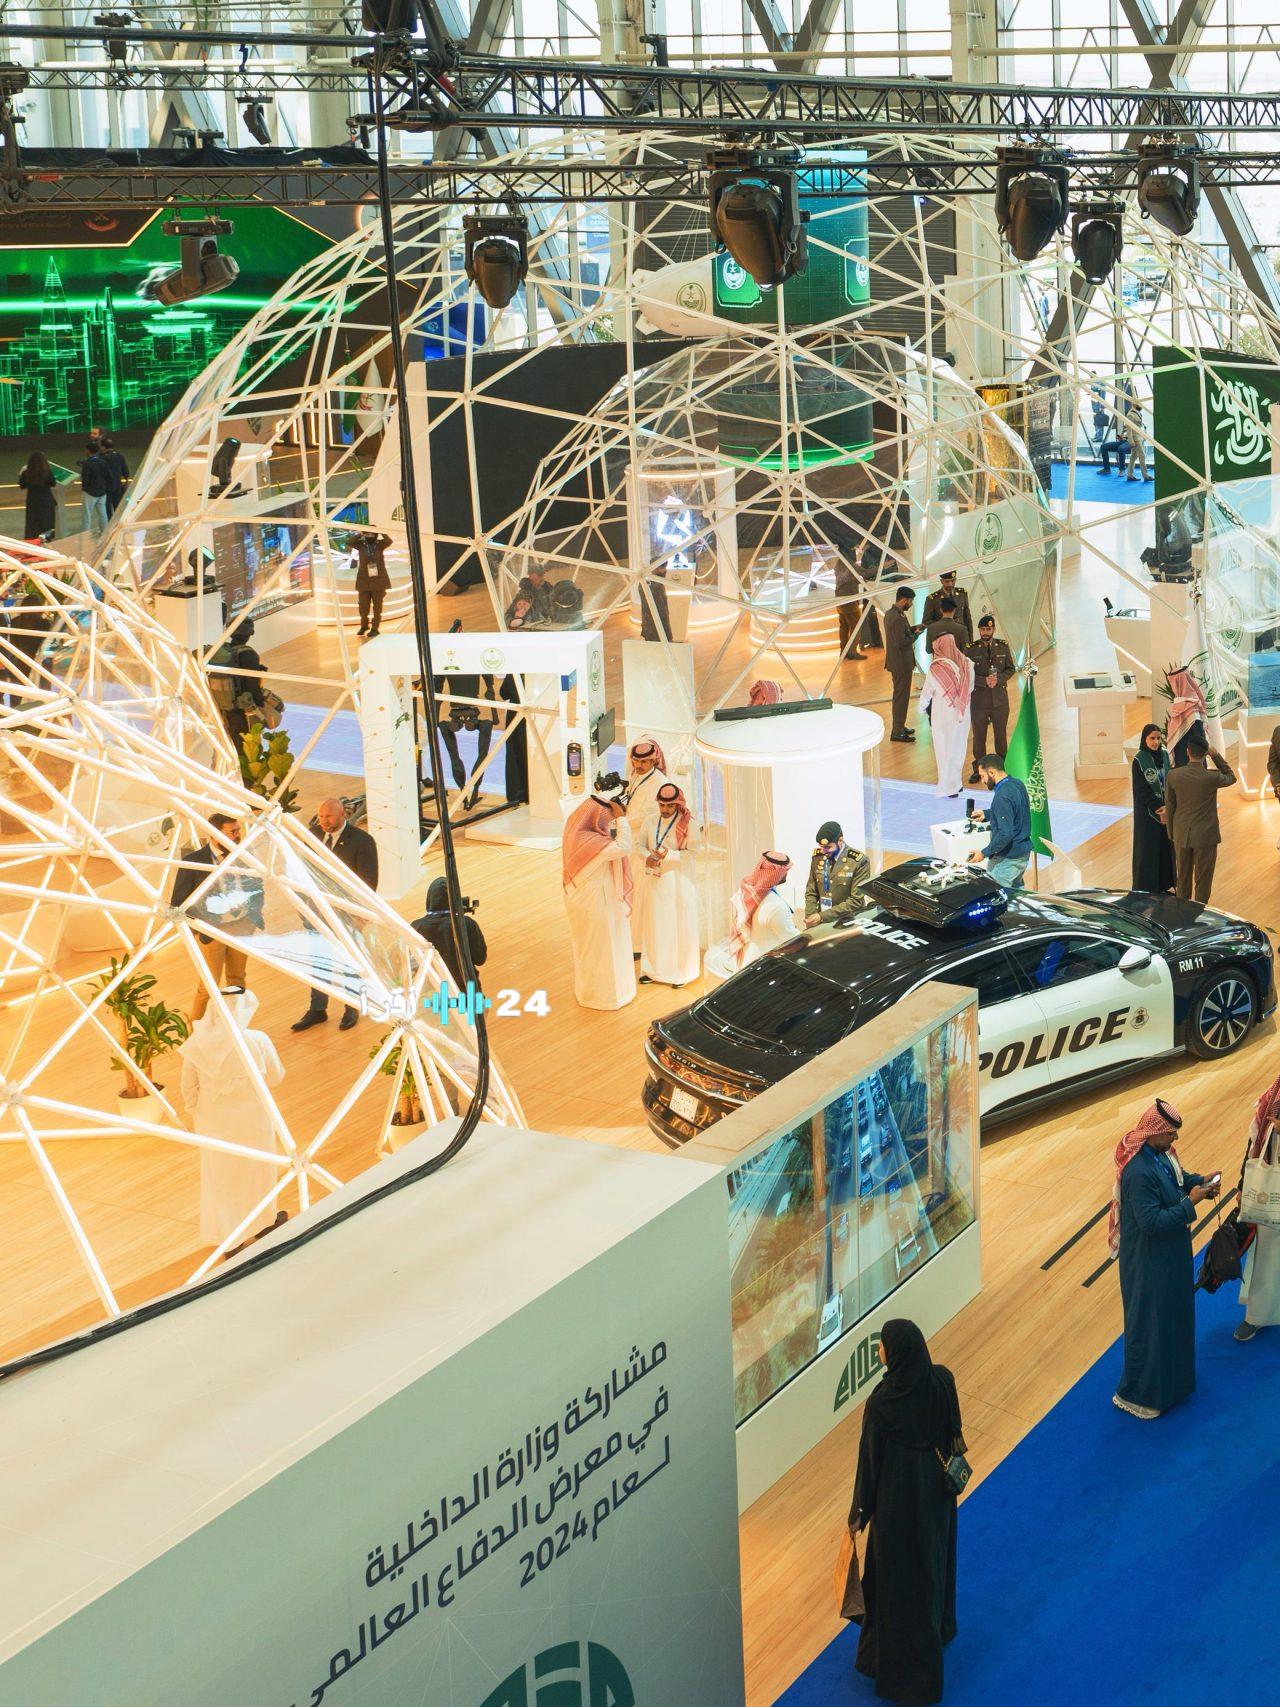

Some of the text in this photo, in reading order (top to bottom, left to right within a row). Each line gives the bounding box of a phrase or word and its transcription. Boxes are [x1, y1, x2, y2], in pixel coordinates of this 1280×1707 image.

[843, 918, 929, 950] POLICE
[1179, 956, 1204, 973] RM 11
[366, 1341, 667, 1588] مشاركة وزارة الداخلية
[627, 1385, 669, 1455] في
[519, 1434, 670, 1588] لعام 2024
[535, 1432, 622, 1524] معرض
[438, 1494, 527, 1608] الدفاع
